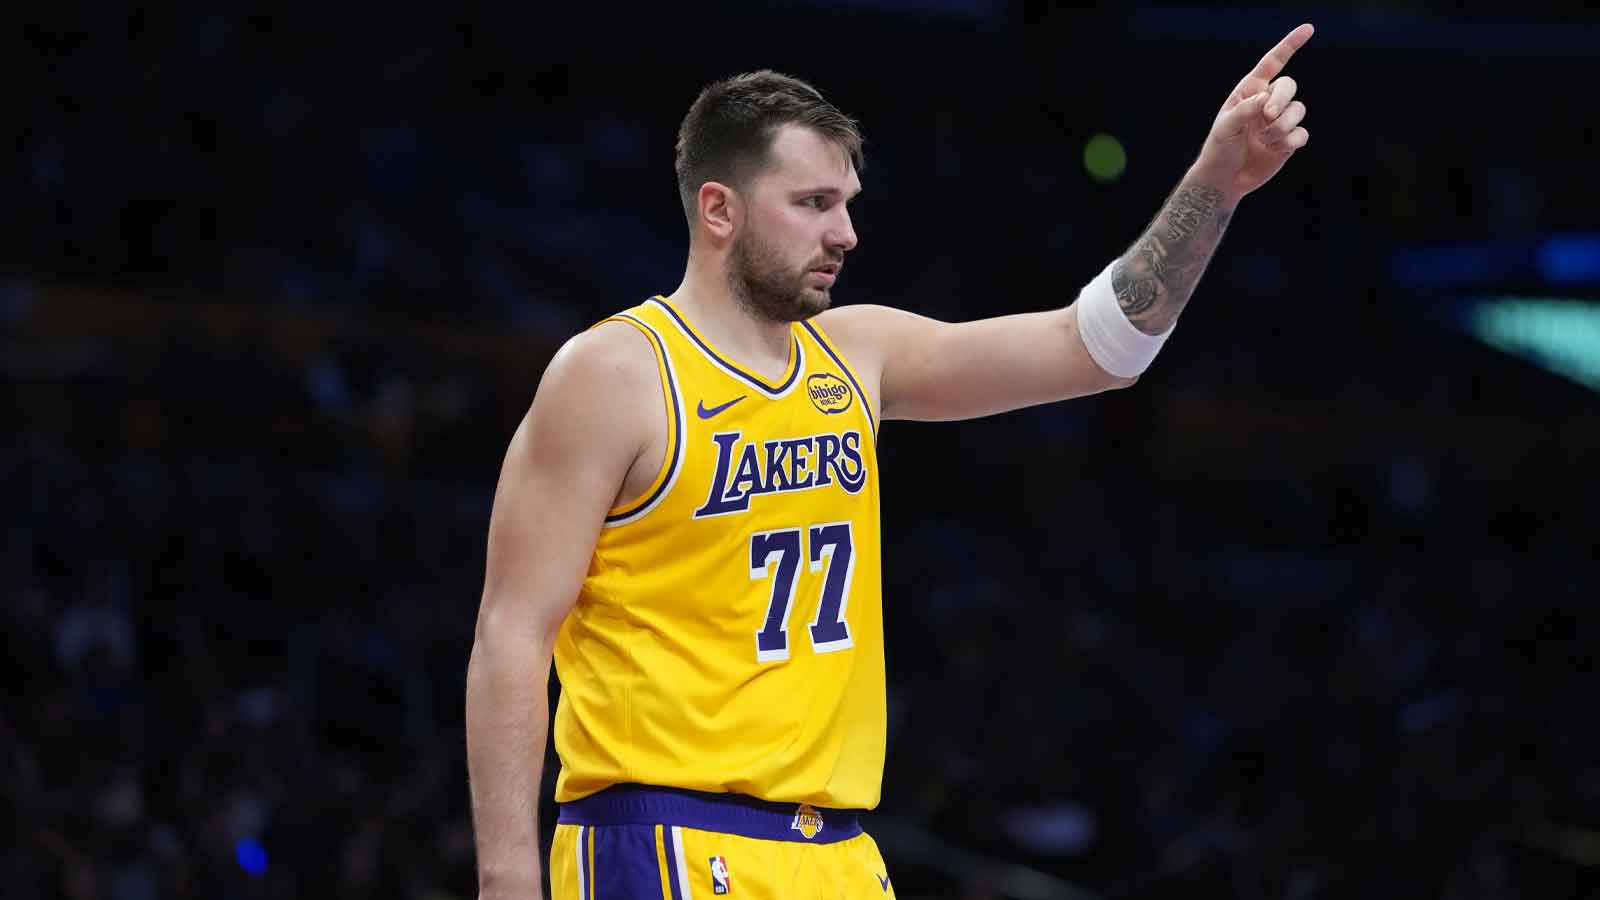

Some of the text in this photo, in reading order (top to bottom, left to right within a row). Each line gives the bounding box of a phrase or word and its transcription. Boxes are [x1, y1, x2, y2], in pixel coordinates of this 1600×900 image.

[809, 383, 848, 401] bibigo
[692, 431, 867, 519] LAKERS
[750, 521, 856, 662] 77
